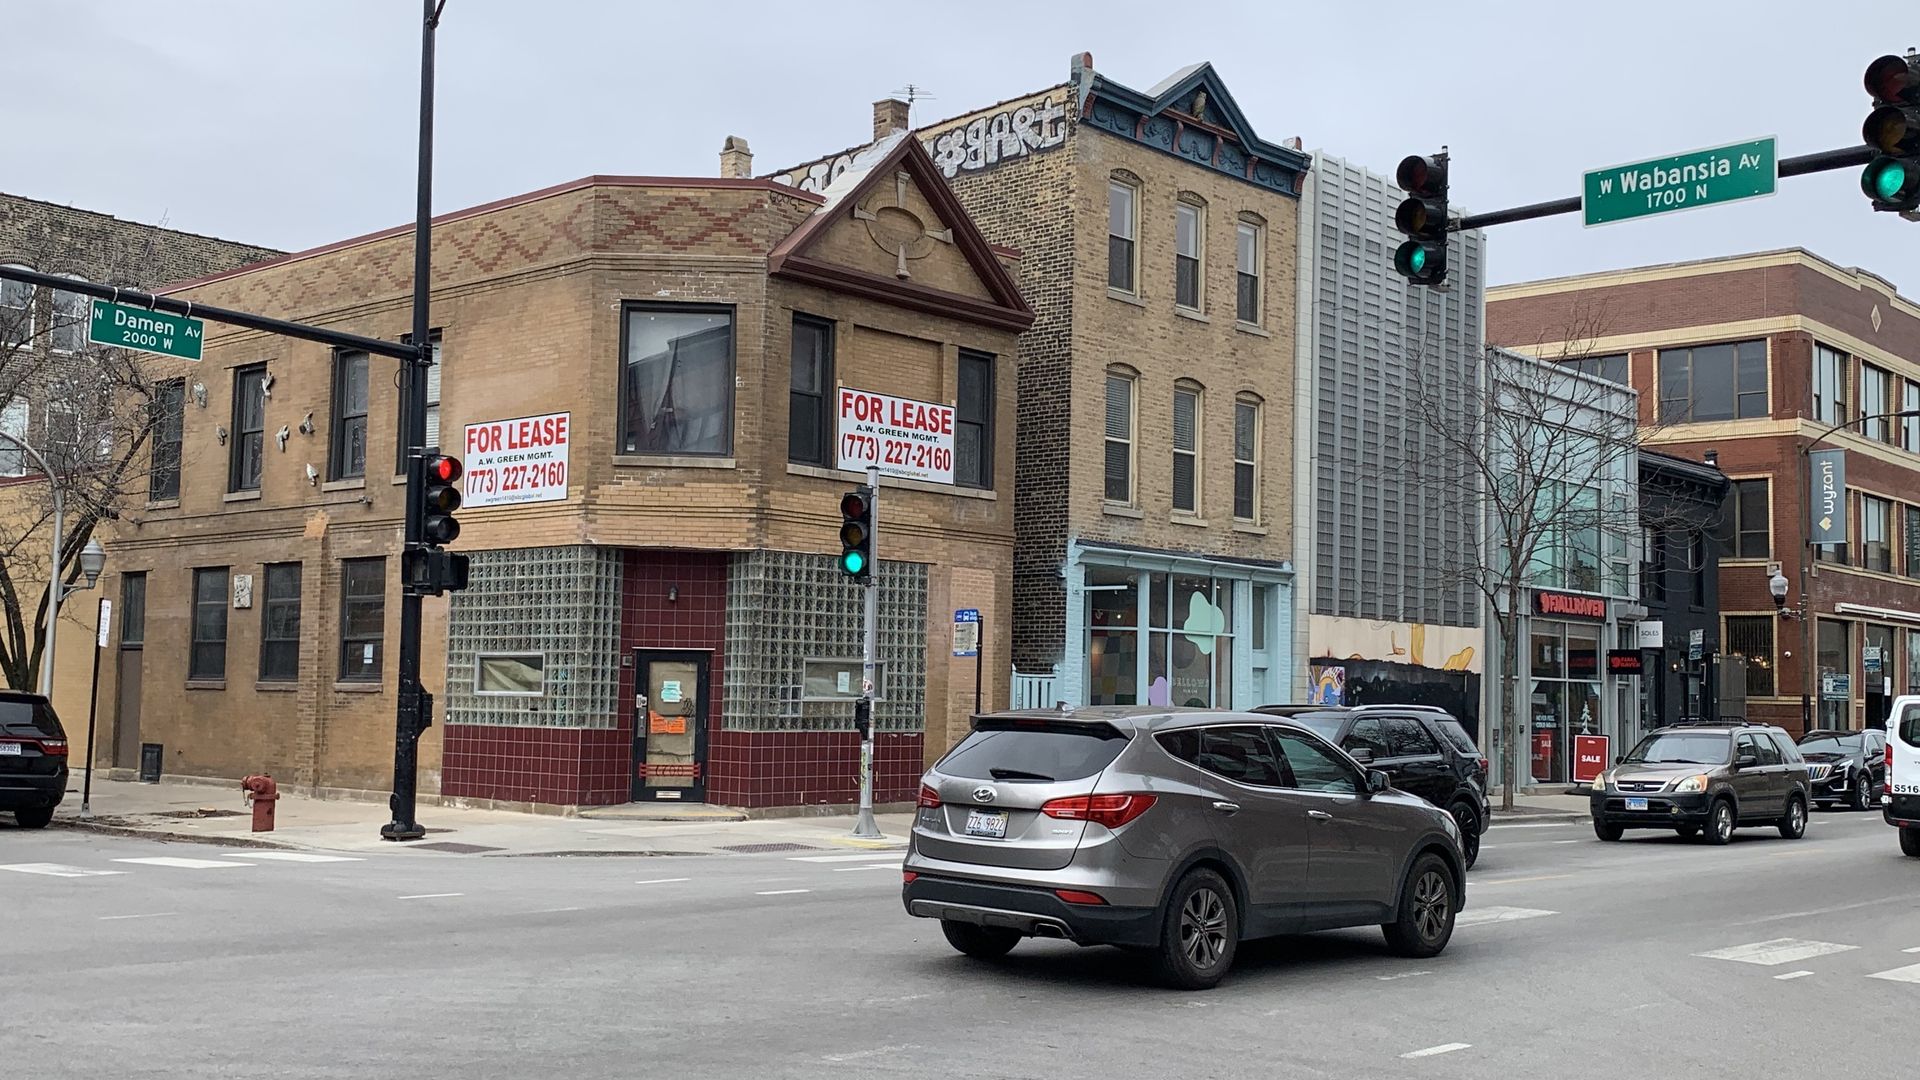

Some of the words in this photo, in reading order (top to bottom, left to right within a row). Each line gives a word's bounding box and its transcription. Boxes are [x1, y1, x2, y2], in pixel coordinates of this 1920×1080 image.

[1600, 178, 1613, 195] W
[1619, 155, 1731, 194] Wabansia
[1738, 153, 1761, 168] Av
[1646, 188, 1686, 209] 1700
[1696, 184, 1708, 200] N
[94, 307, 103, 320] N
[114, 309, 174, 336] Damen
[184, 326, 201, 338] Av
[122, 330, 157, 346] 2000
[163, 337, 173, 350] W
[841, 391, 883, 424] FOR
[890, 400, 952, 435] LEASE
[467, 425, 502, 454] FOR
[508, 416, 567, 449] LEASE
[855, 424, 876, 433] A.W.
[878, 427, 909, 439] GREEN
[911, 432, 940, 444] MGMT.
[478, 458, 495, 466] A.W.
[497, 454, 525, 464] GREEN
[526, 451, 554, 461] MGMT.
[841, 433, 880, 465] (773)
[884, 439, 951, 472] 227-2160
[466, 467, 498, 498] (773)
[502, 460, 565, 491] 227-2160
[1820, 460, 1837, 515] wyzant
[1581, 755, 1601, 763] SALE
[1894, 784, 1920, 794] S516
